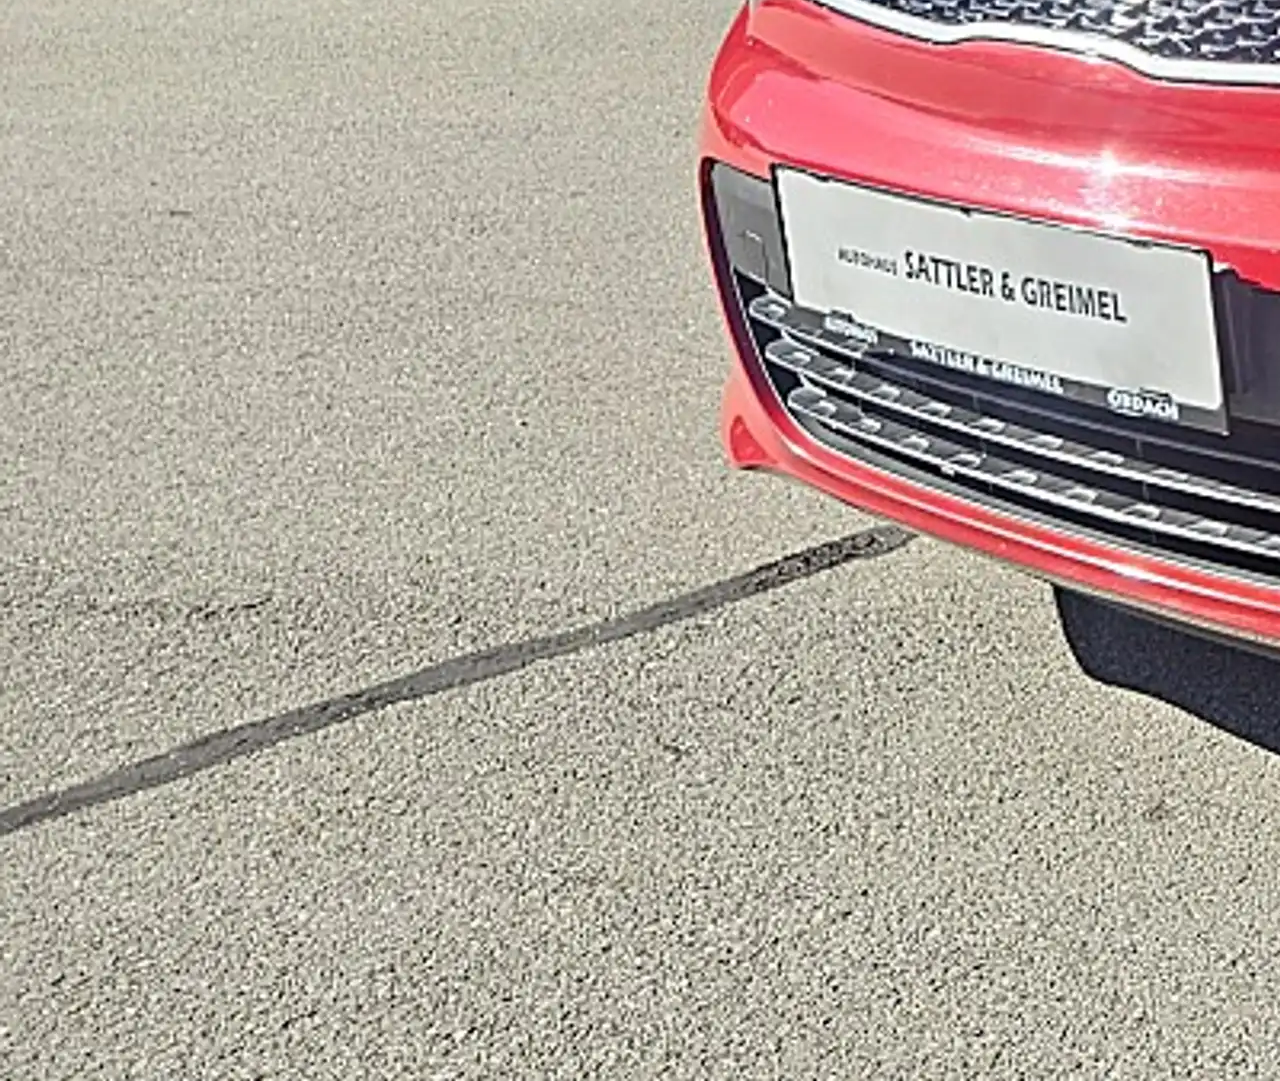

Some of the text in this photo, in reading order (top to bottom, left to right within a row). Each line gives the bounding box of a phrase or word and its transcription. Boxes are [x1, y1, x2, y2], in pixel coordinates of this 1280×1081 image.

[904, 250, 995, 298] SATTLER
[1000, 272, 1016, 302] &
[1020, 276, 1127, 324] GREIMEL
